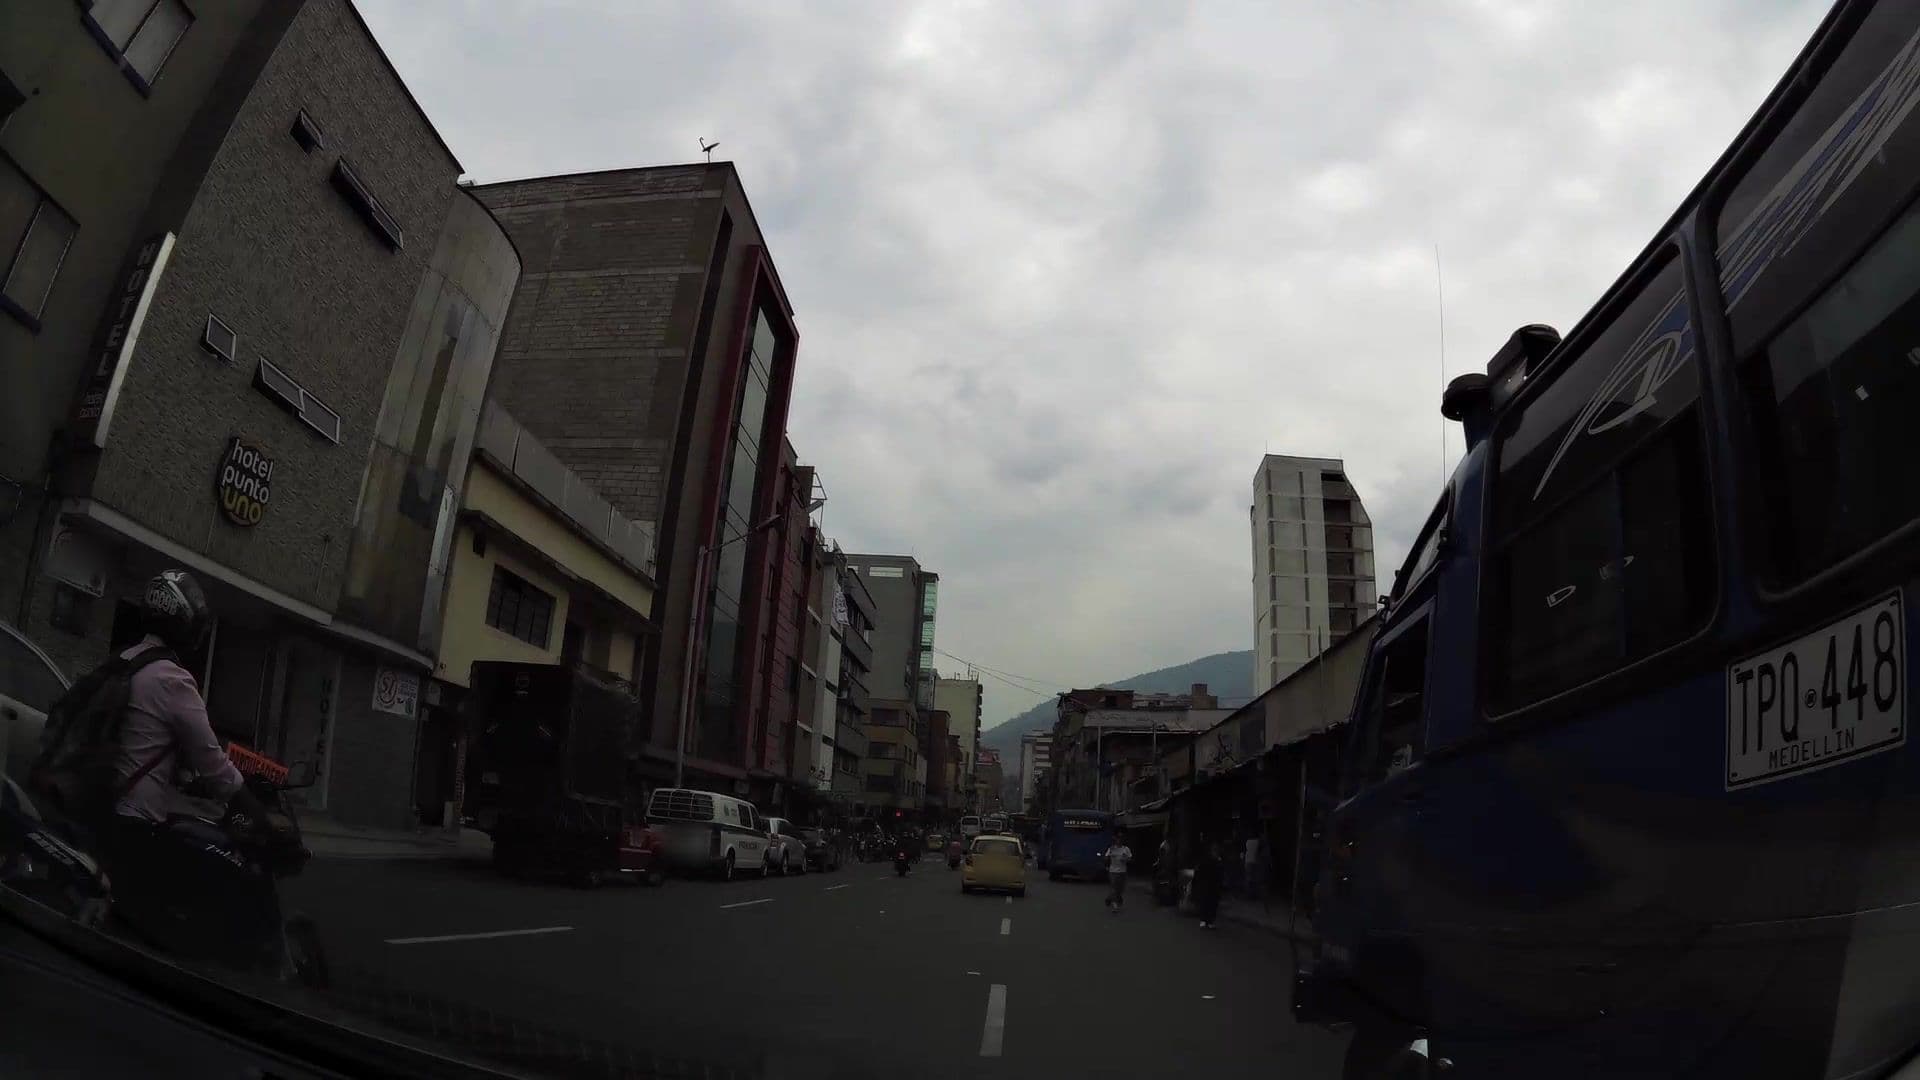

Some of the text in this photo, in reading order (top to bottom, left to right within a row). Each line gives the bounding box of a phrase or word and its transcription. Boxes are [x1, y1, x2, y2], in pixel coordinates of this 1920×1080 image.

[96, 239, 157, 378] HOTEL
[231, 438, 274, 482] hotel
[222, 465, 270, 504] punto
[223, 486, 262, 524] uno
[1821, 611, 1898, 730] 448
[1768, 727, 1856, 769] MEDELLIN
